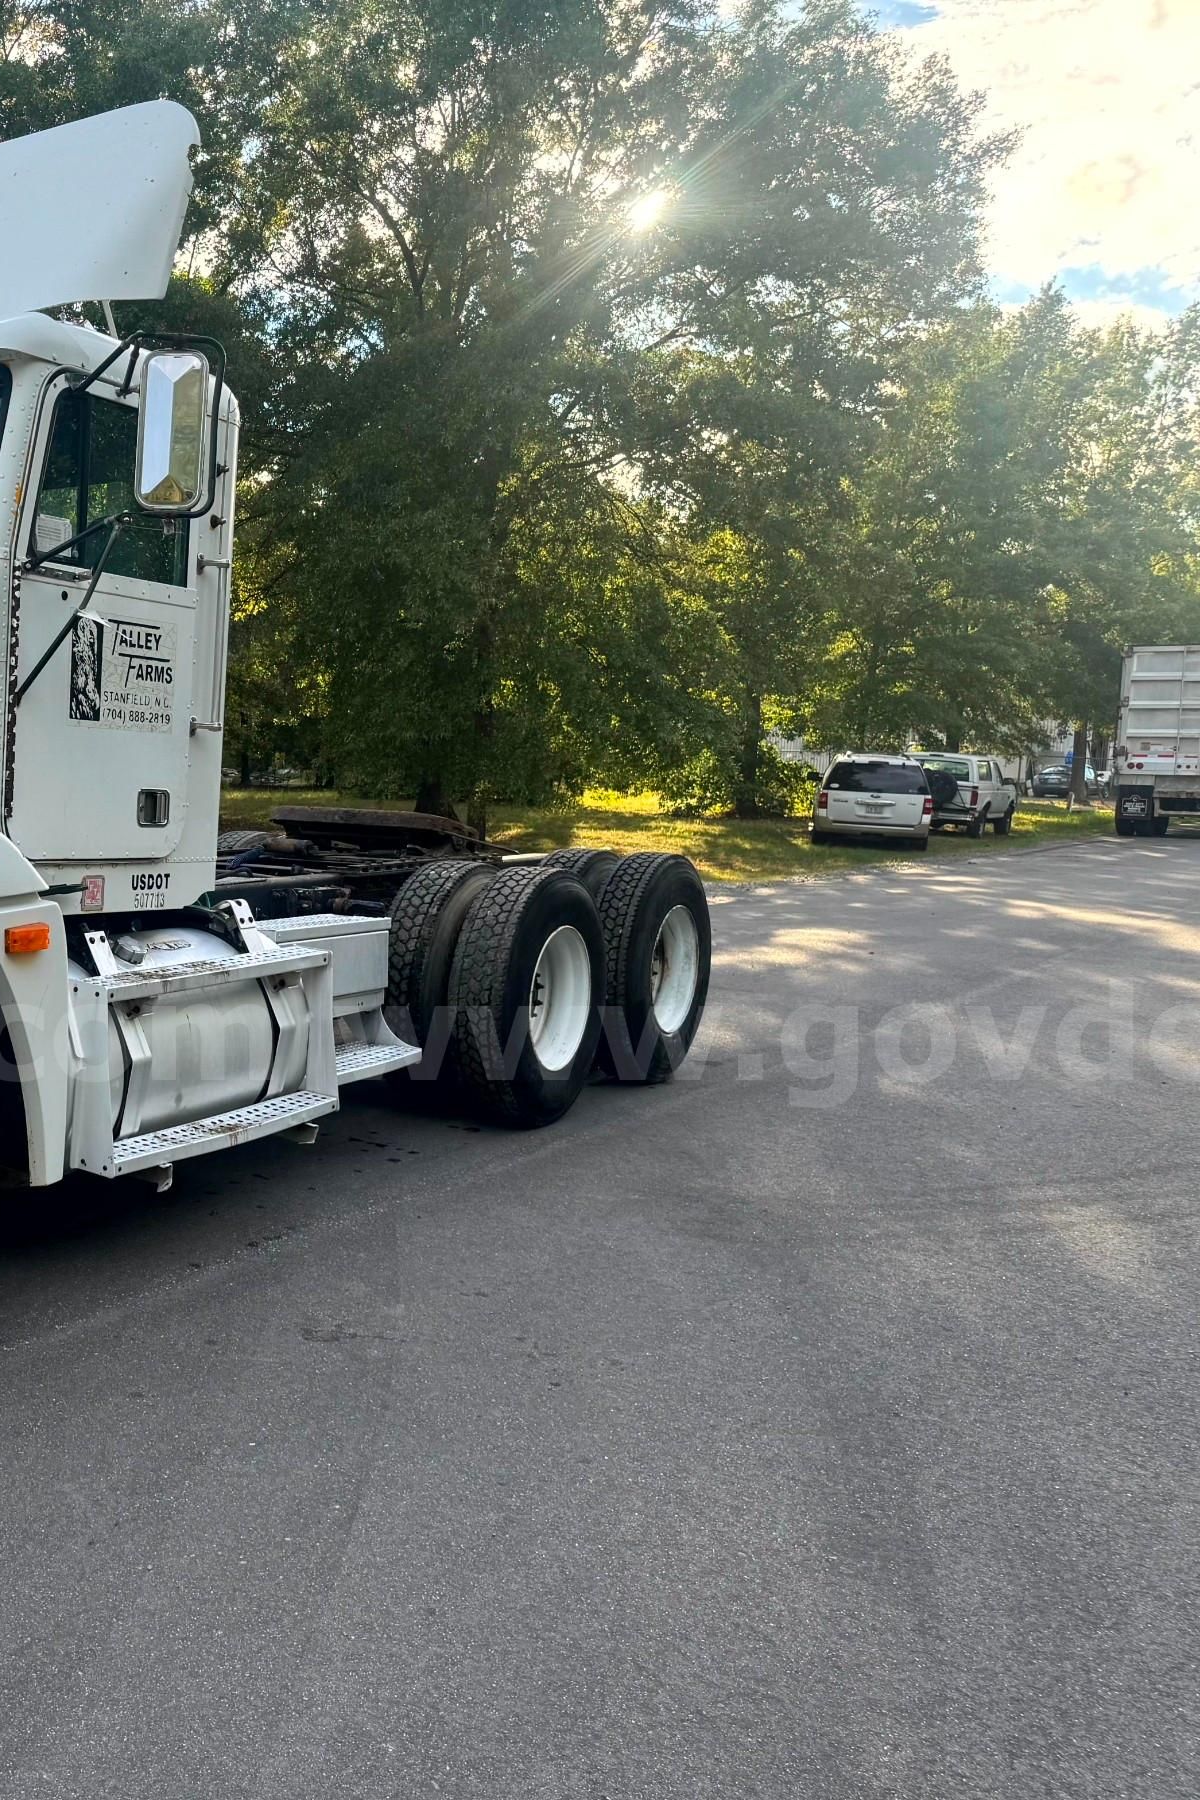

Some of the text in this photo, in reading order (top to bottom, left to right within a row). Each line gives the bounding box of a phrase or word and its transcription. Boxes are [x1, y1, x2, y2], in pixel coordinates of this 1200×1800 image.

[108, 618, 162, 655] TALLEY
[119, 652, 173, 688] FARMS
[102, 707, 171, 725] (704) 888-2819
[131, 873, 171, 891] USDOT
